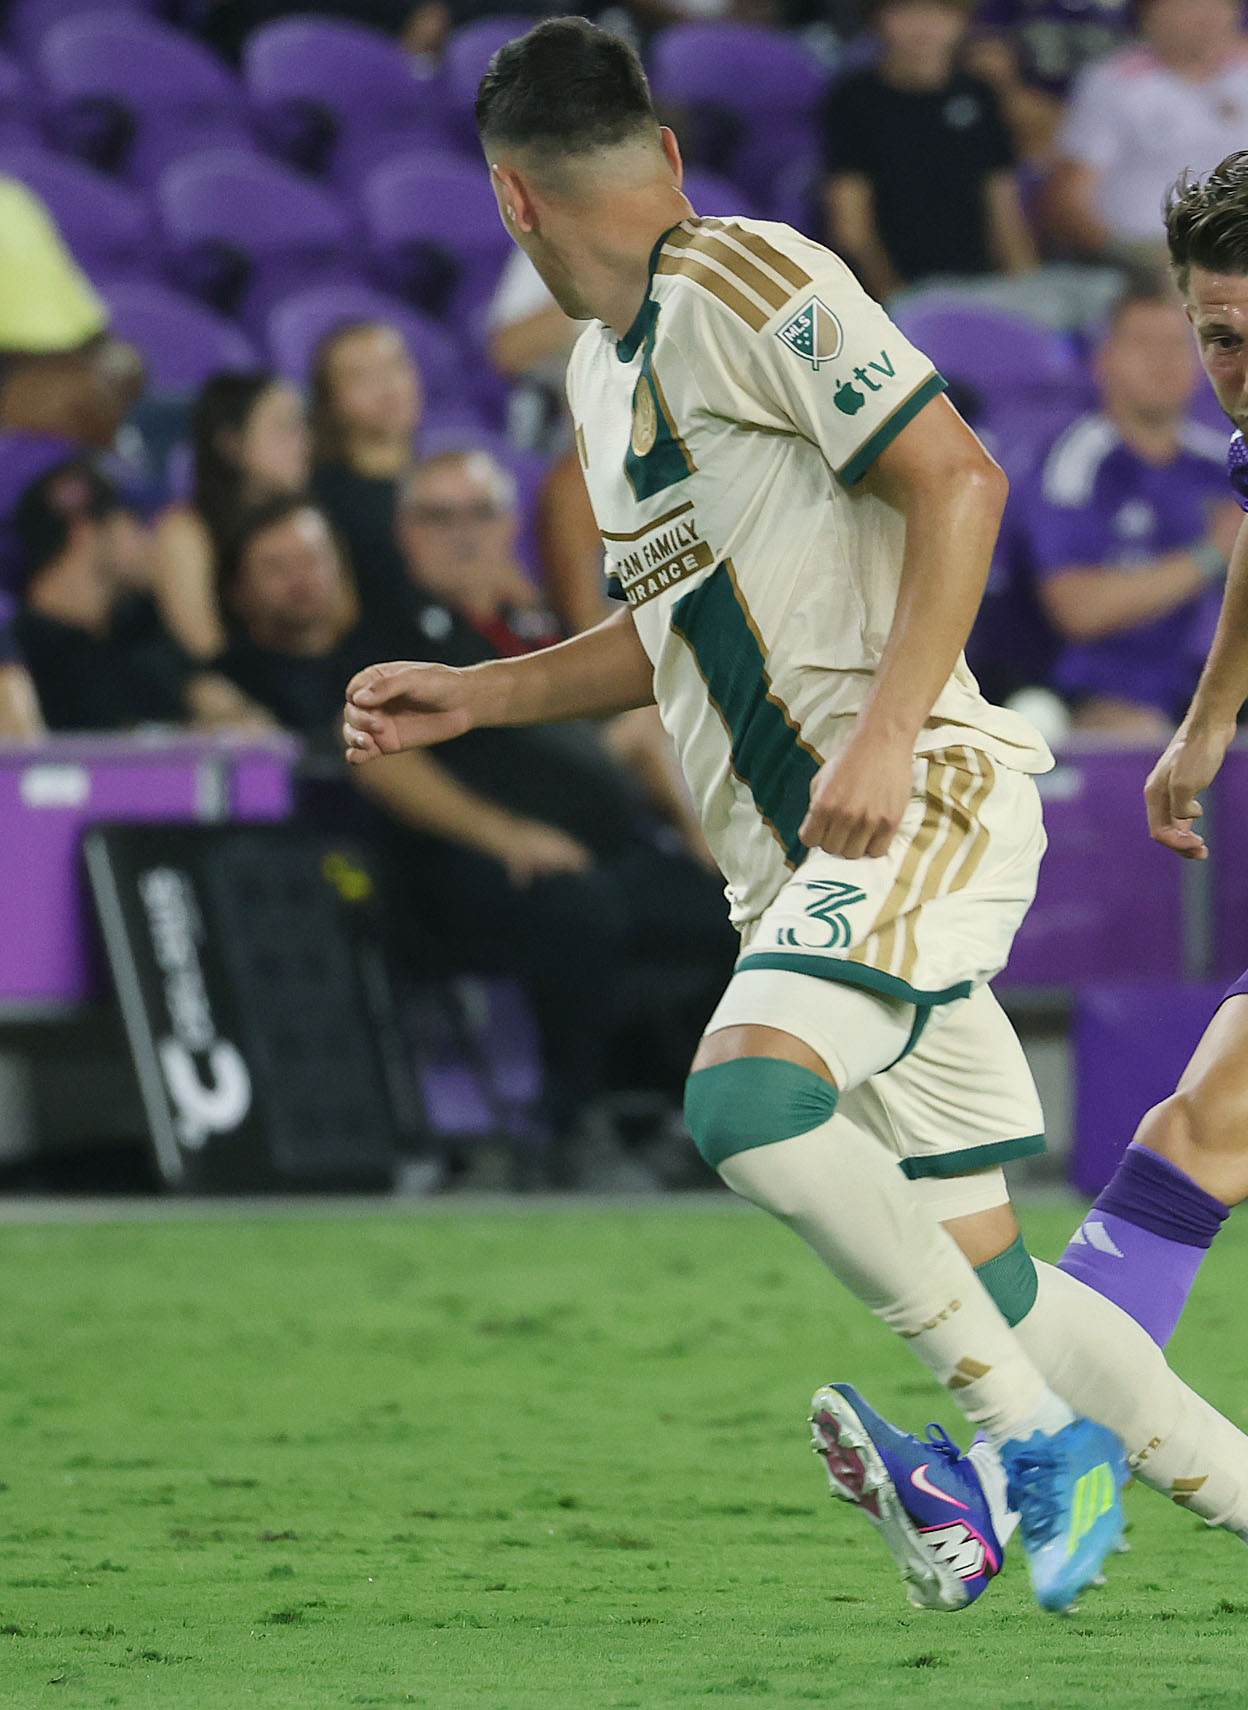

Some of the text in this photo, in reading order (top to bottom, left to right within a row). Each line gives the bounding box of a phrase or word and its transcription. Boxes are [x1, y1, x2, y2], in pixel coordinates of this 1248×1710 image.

[783, 315, 811, 342] MLS
[853, 350, 895, 391] tv
[642, 519, 699, 567] FAMILY
[777, 880, 867, 948] 3
